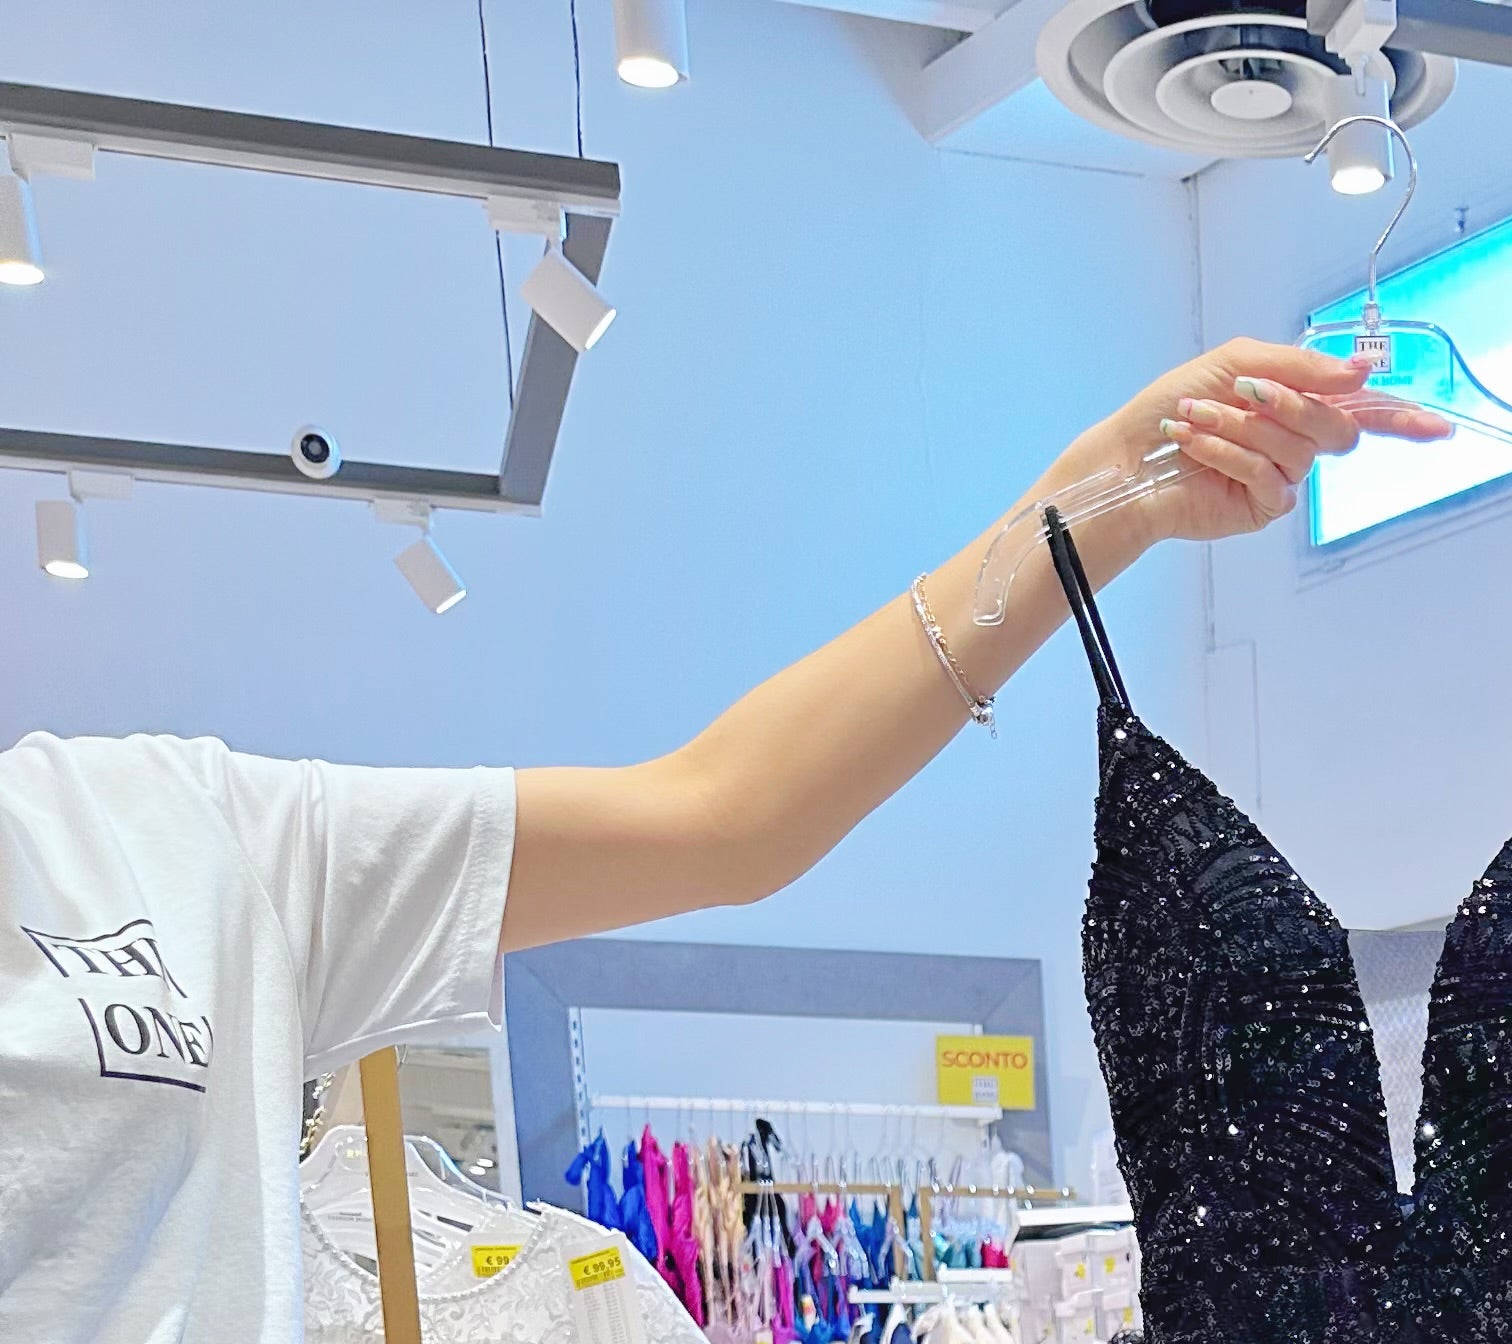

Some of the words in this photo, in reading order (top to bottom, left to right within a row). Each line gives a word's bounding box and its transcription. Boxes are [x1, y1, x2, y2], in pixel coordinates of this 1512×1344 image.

[1359, 341, 1387, 351] THE
[104, 1003, 208, 1067] ONE
[942, 1050, 1028, 1070] SCONTO
[486, 1256, 493, 1265] €
